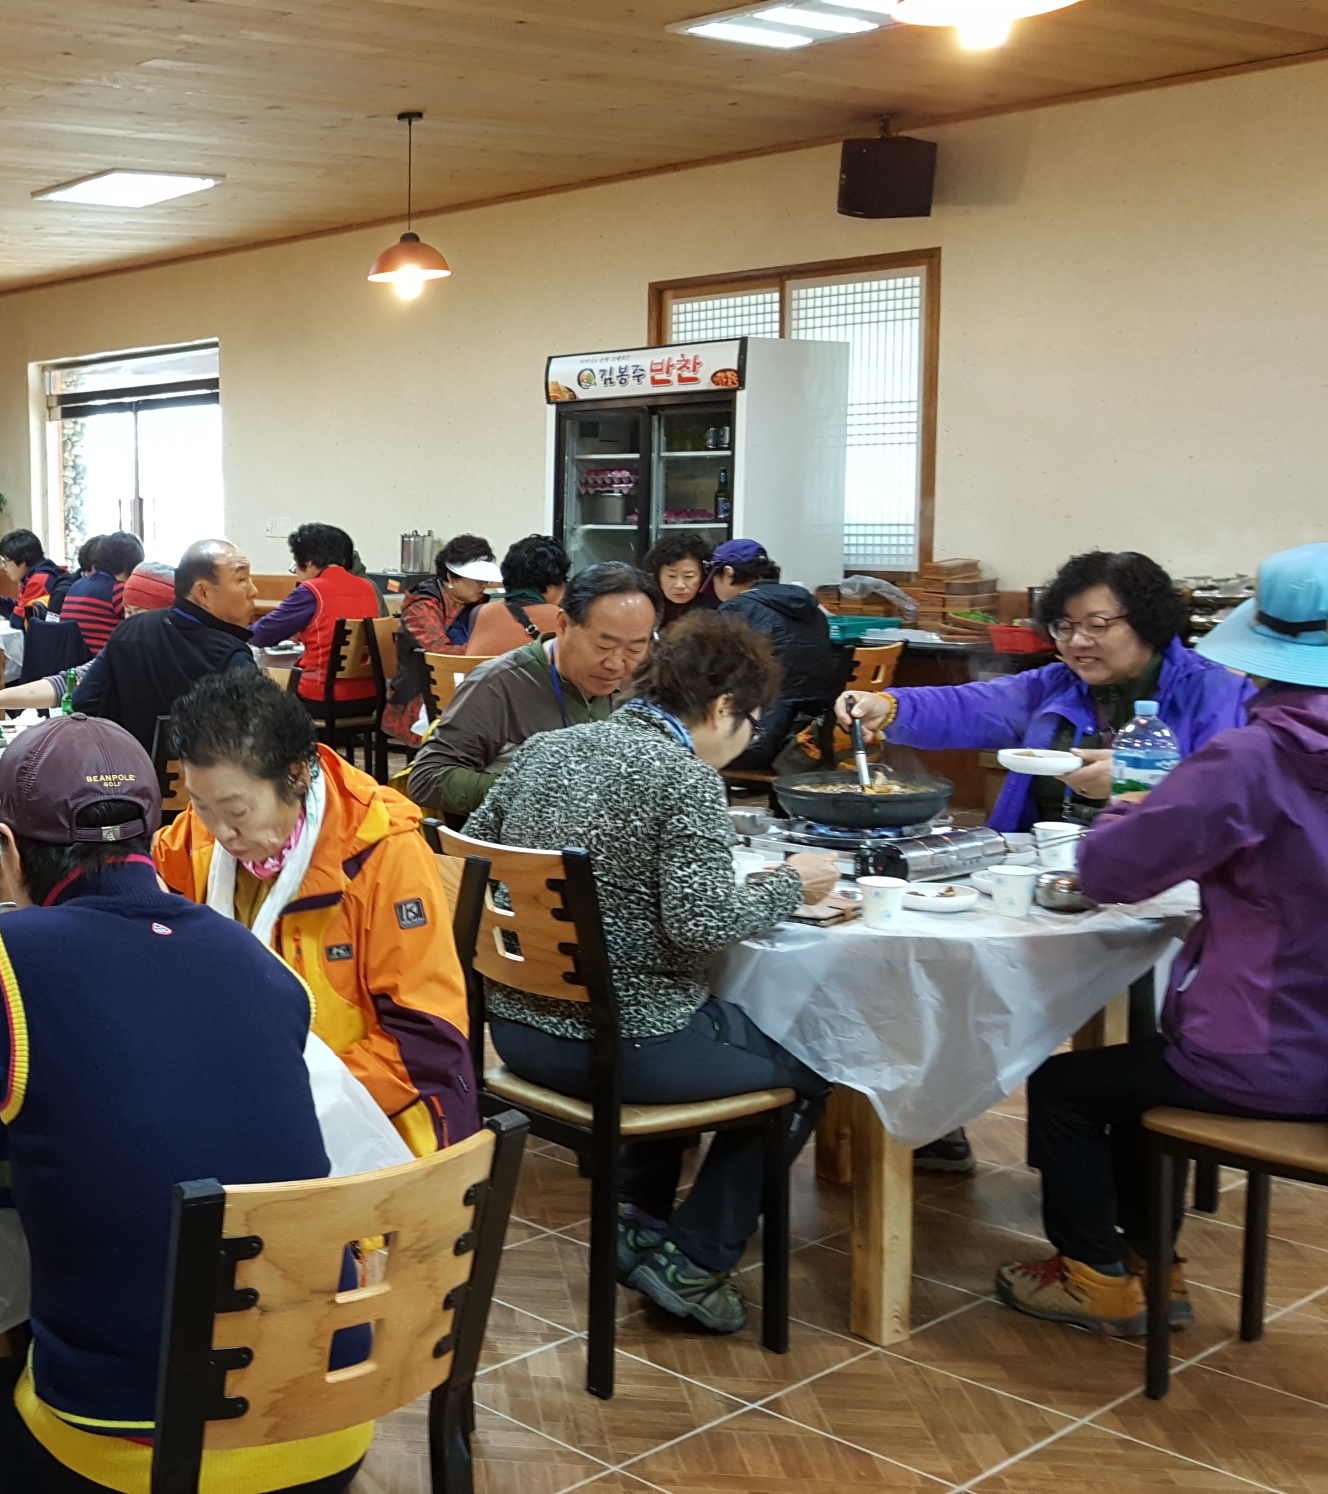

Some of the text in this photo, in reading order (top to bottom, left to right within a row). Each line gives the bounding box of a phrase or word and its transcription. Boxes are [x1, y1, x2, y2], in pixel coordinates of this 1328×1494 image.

[598, 353, 702, 387] 김봉주 반찬
[86, 774, 136, 782] BEANPOLE
